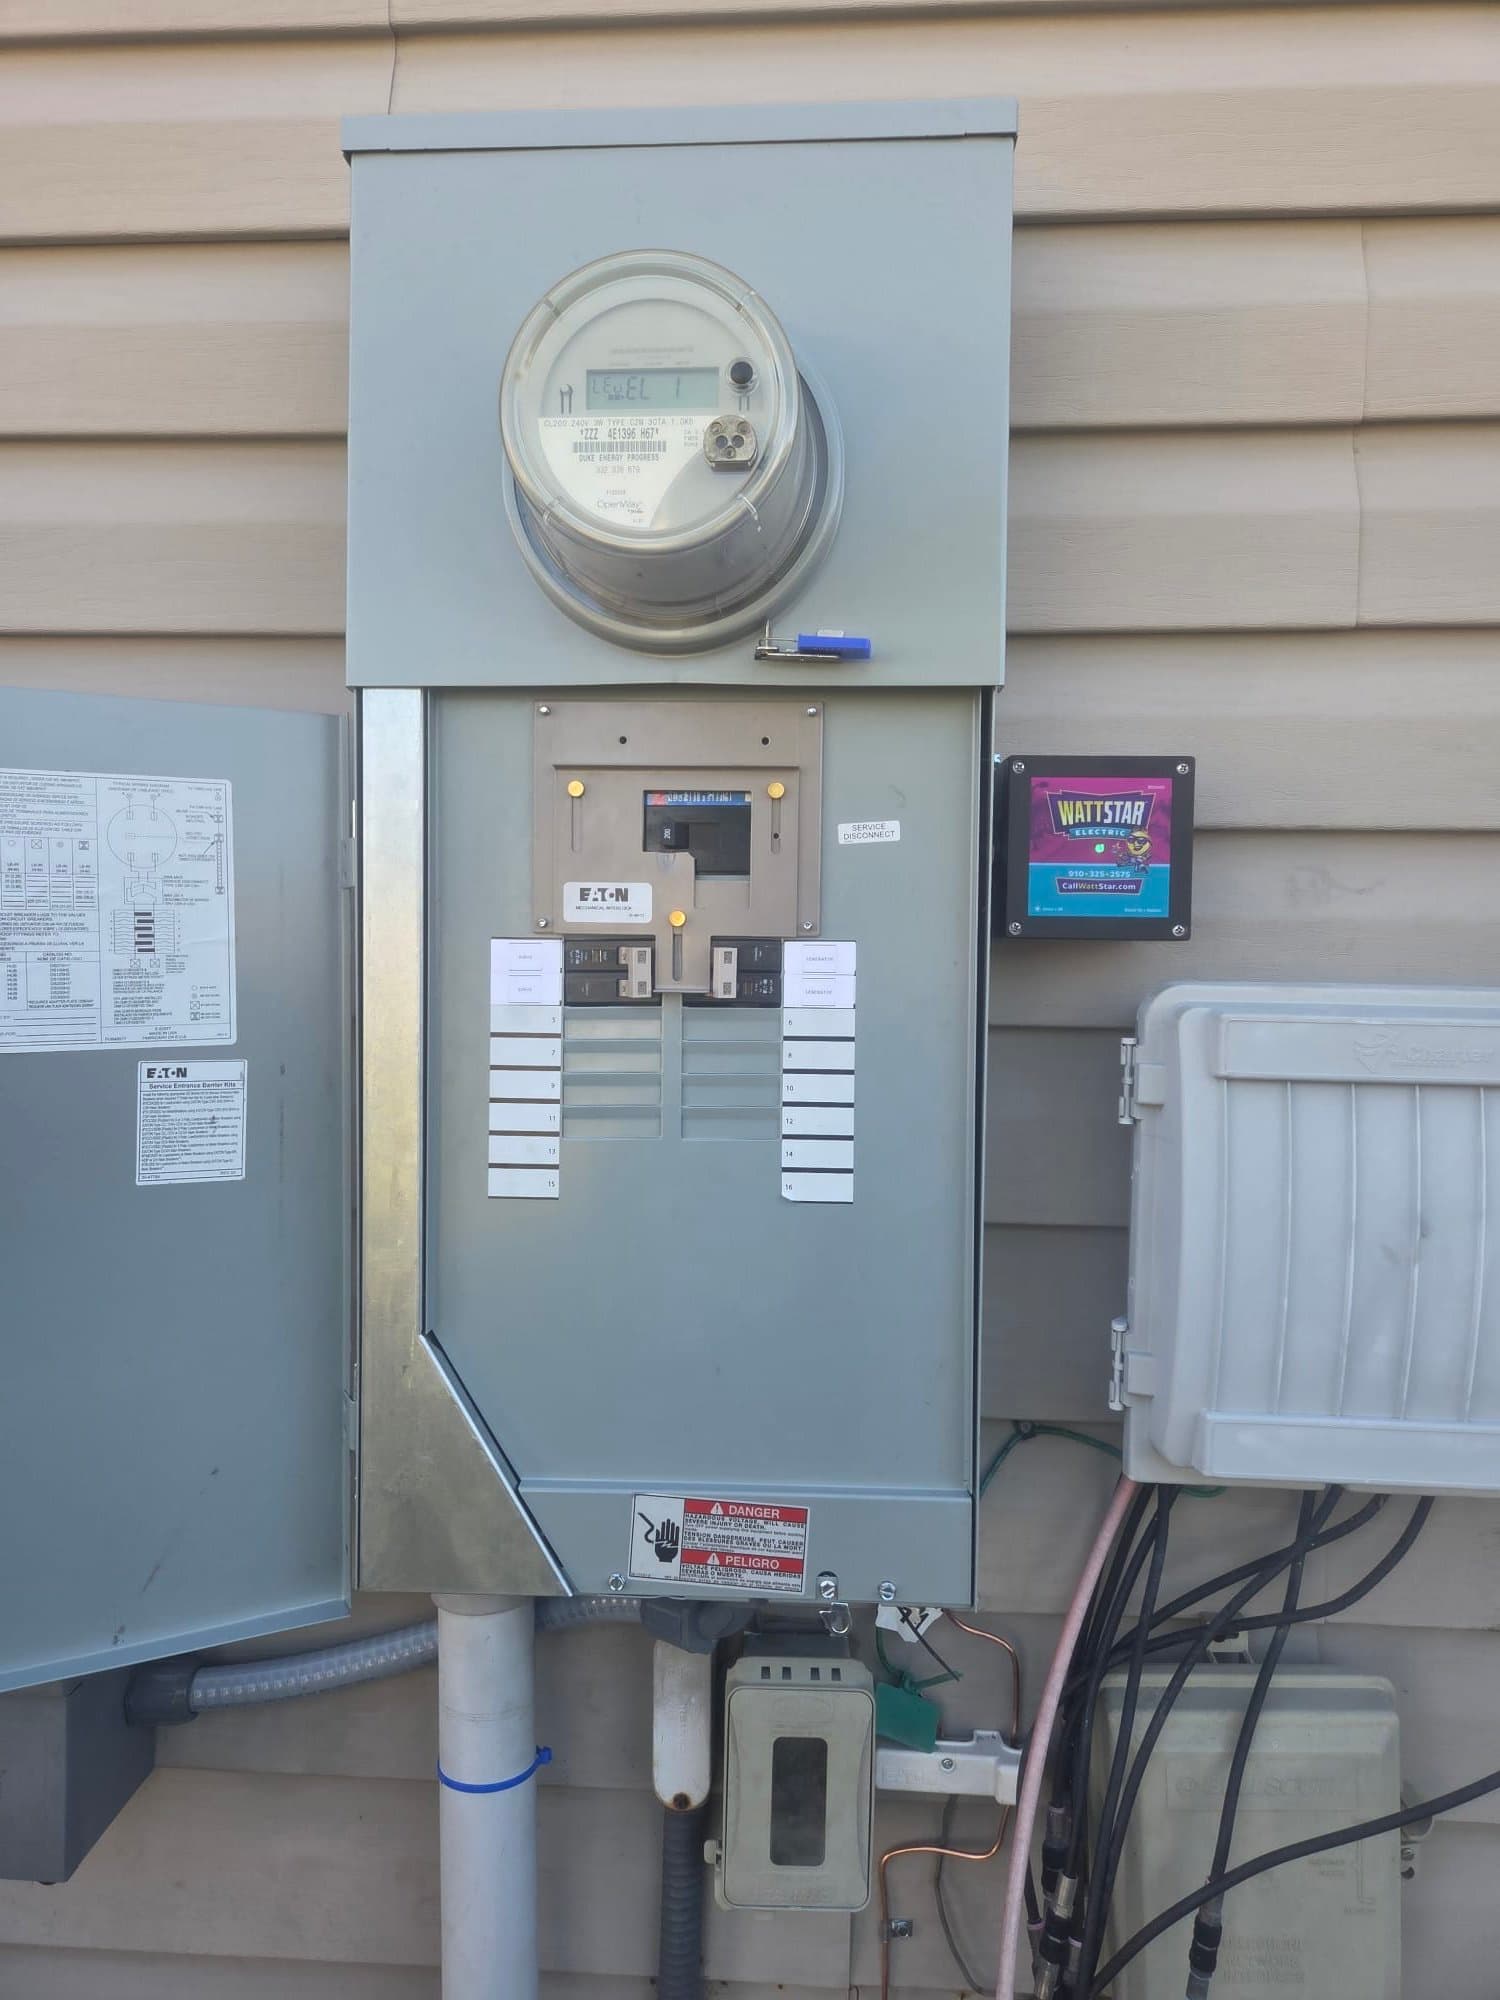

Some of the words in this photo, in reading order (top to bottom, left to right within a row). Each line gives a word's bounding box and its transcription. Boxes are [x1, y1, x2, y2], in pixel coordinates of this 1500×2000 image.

[579, 454, 595, 462] DUKE
[627, 454, 659, 462] PROGRESS
[1058, 800, 1145, 826] WATTSTAR
[852, 823, 887, 832] SERVICE
[844, 830, 895, 840] DISCONNECT
[1062, 882, 1136, 891] CallWattStar.com
[580, 887, 629, 902] EATON
[147, 1067, 187, 1078] EATON
[728, 1505, 780, 1519] DANGER
[725, 1555, 779, 1570] PELIGRO
